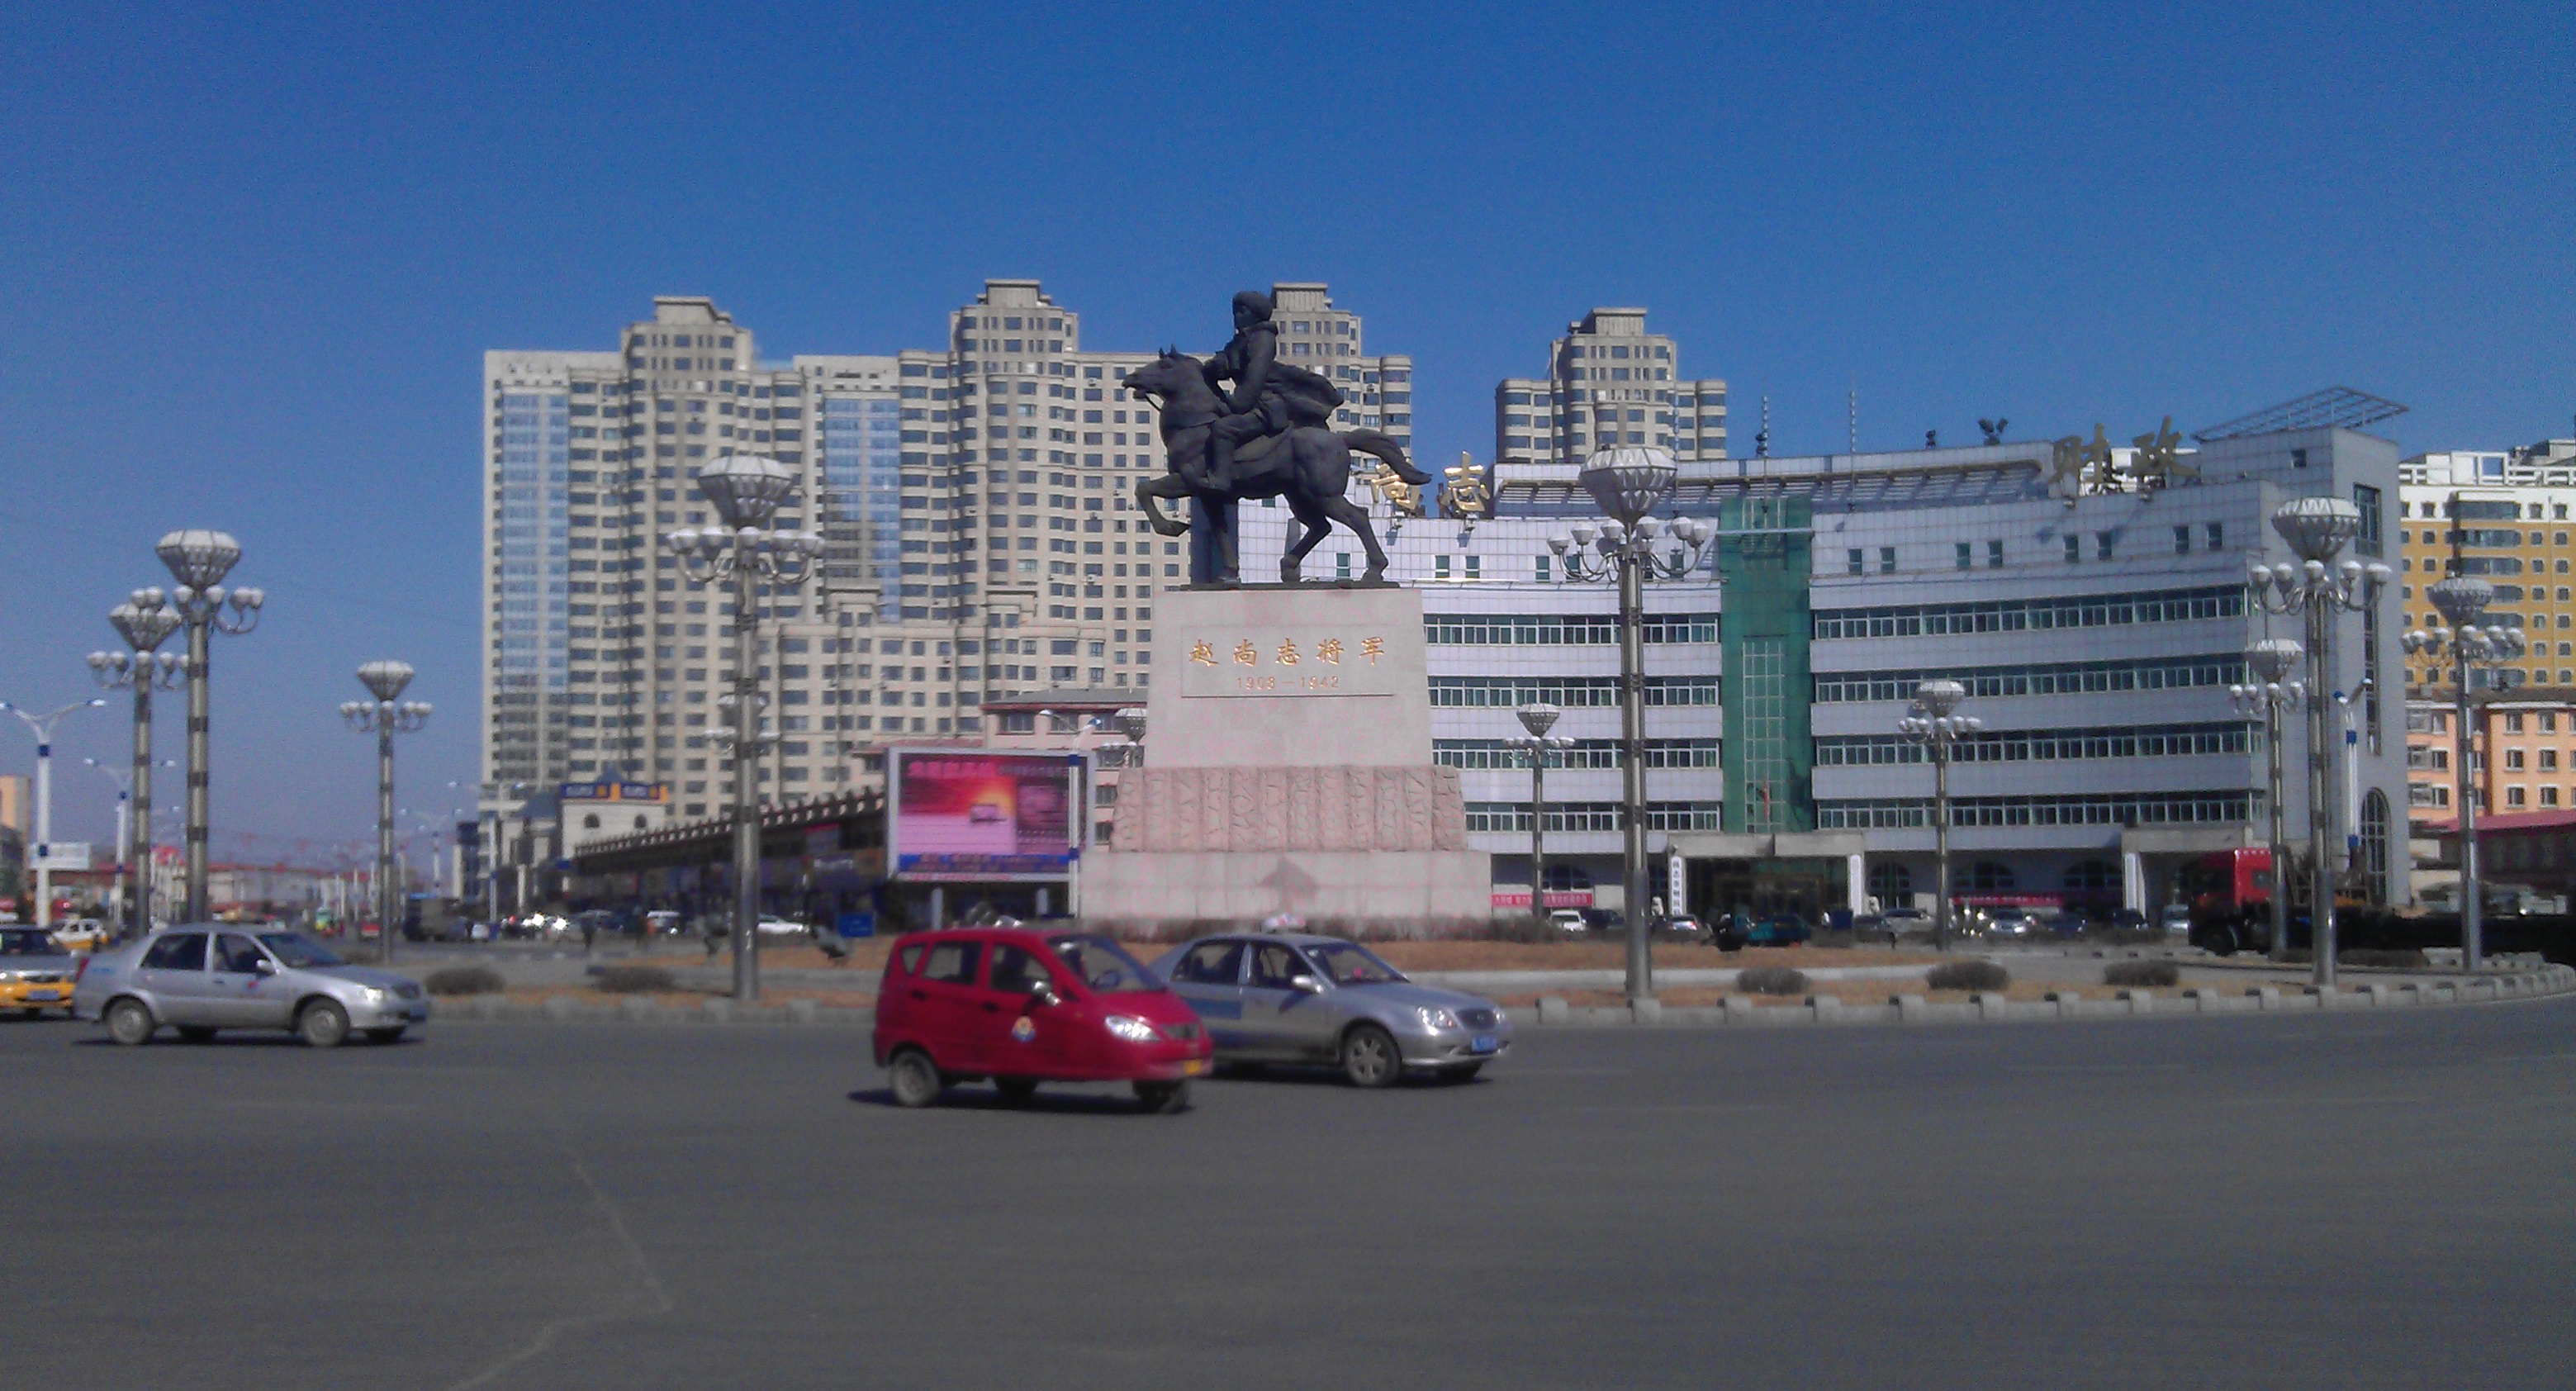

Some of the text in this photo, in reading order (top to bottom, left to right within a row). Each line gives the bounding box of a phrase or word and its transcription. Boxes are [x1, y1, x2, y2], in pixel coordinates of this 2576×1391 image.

[1188, 636, 1385, 667] 赵尚志将军
